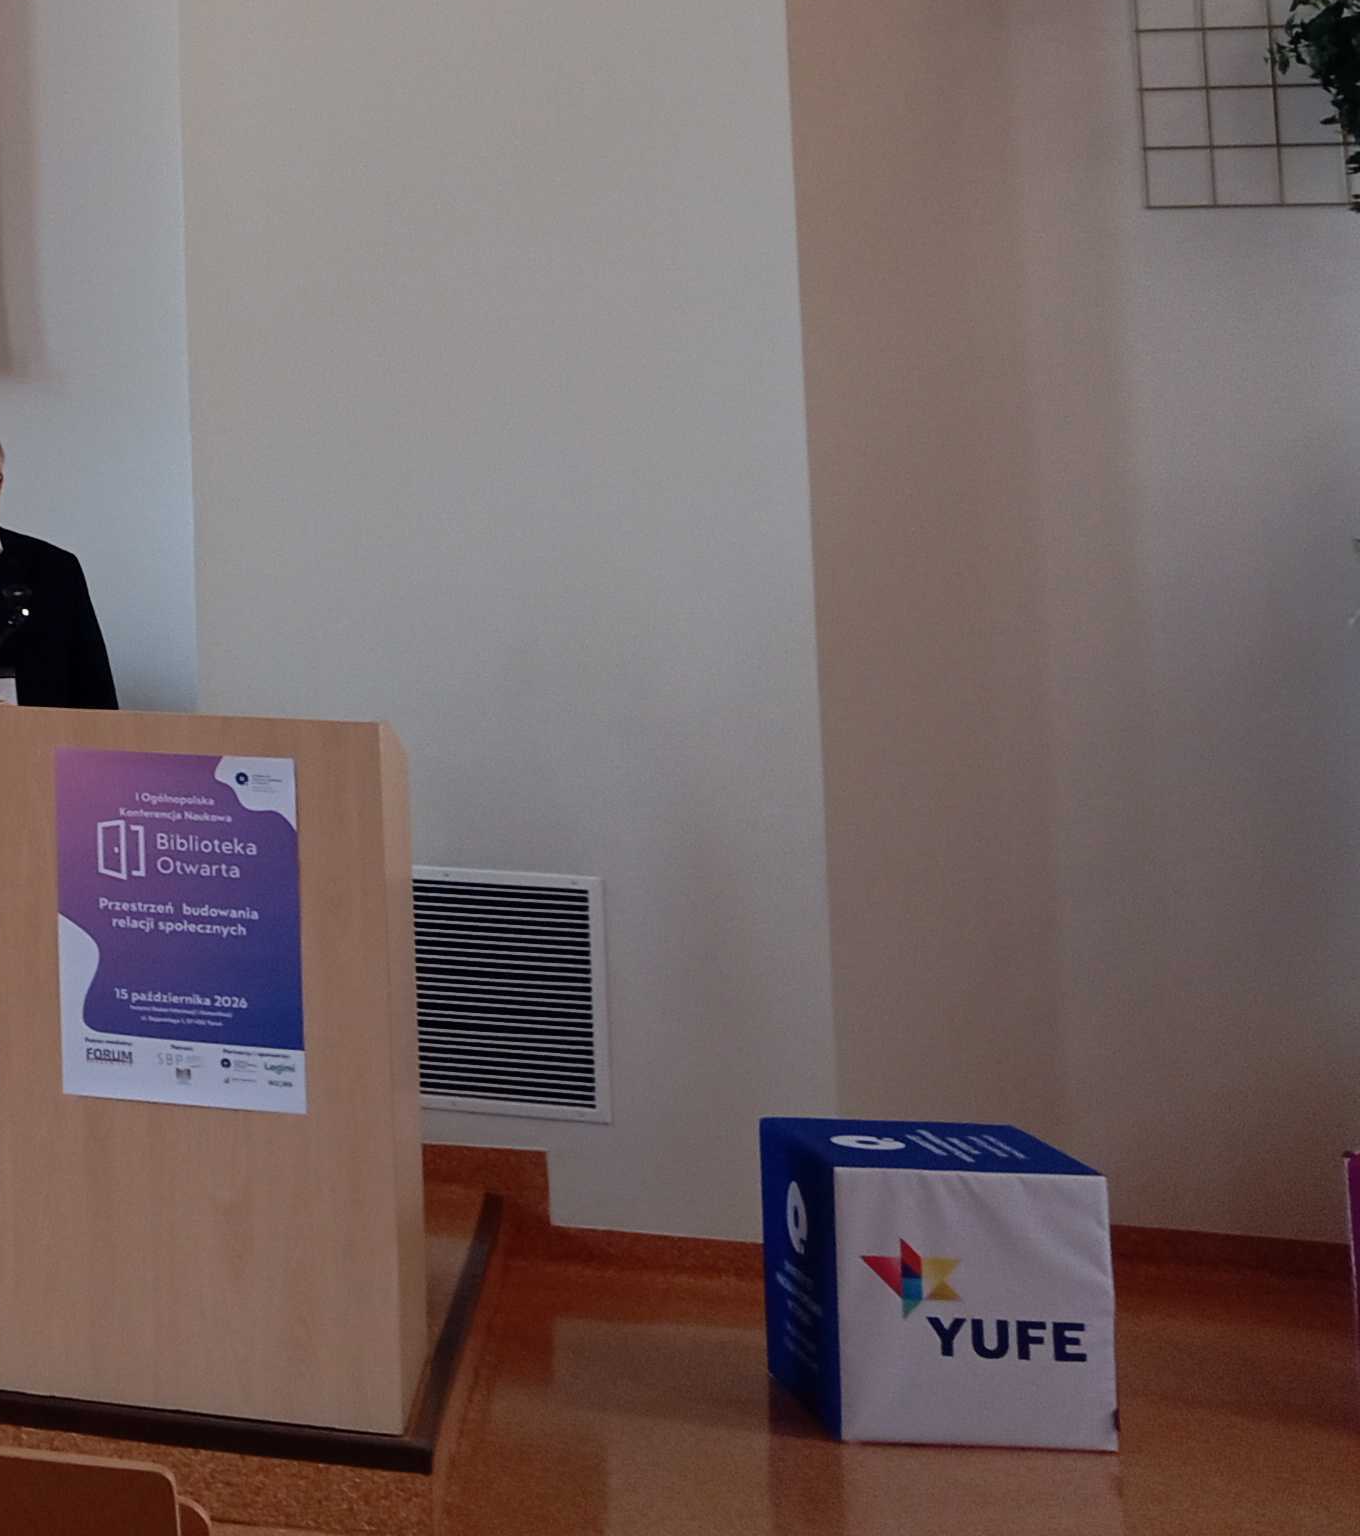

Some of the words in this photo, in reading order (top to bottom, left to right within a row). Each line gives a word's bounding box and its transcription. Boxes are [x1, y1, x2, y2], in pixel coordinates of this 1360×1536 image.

[141, 793, 215, 806] Ogólnopolska
[119, 807, 182, 822] Konferencja
[184, 811, 233, 823] Naukowa
[156, 833, 257, 855] Biblioteka
[157, 856, 241, 878] Otwarta
[98, 897, 175, 914] Przestrzeń
[182, 904, 259, 920] budowania
[112, 917, 155, 932] relacji
[158, 919, 247, 938] społecznych
[114, 987, 128, 999] 15
[131, 990, 211, 1006] października
[213, 995, 248, 1009] 2026
[86, 1047, 133, 1064] FORUM
[926, 1316, 1088, 1363] YUFE
